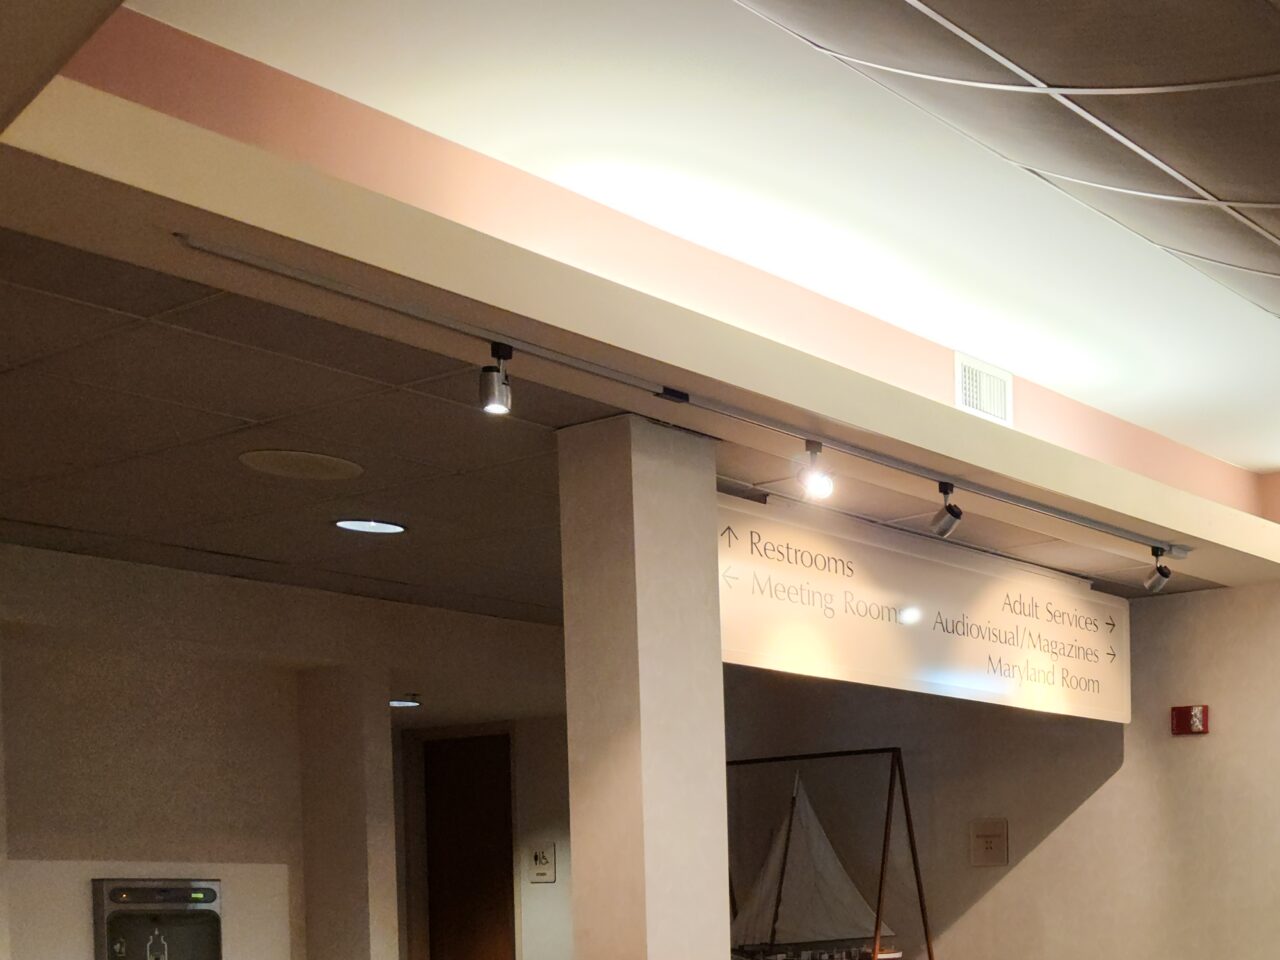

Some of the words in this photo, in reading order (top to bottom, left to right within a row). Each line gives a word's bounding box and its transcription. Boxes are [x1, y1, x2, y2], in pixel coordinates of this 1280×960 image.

[750, 530, 855, 578] Restrooms
[751, 570, 835, 619] Meeting
[1002, 593, 1040, 620] Adult
[1046, 602, 1099, 633] Services
[932, 610, 1099, 663] Audiovisual/Magazines
[987, 654, 1055, 688] Maryland
[1061, 667, 1100, 694] Room
